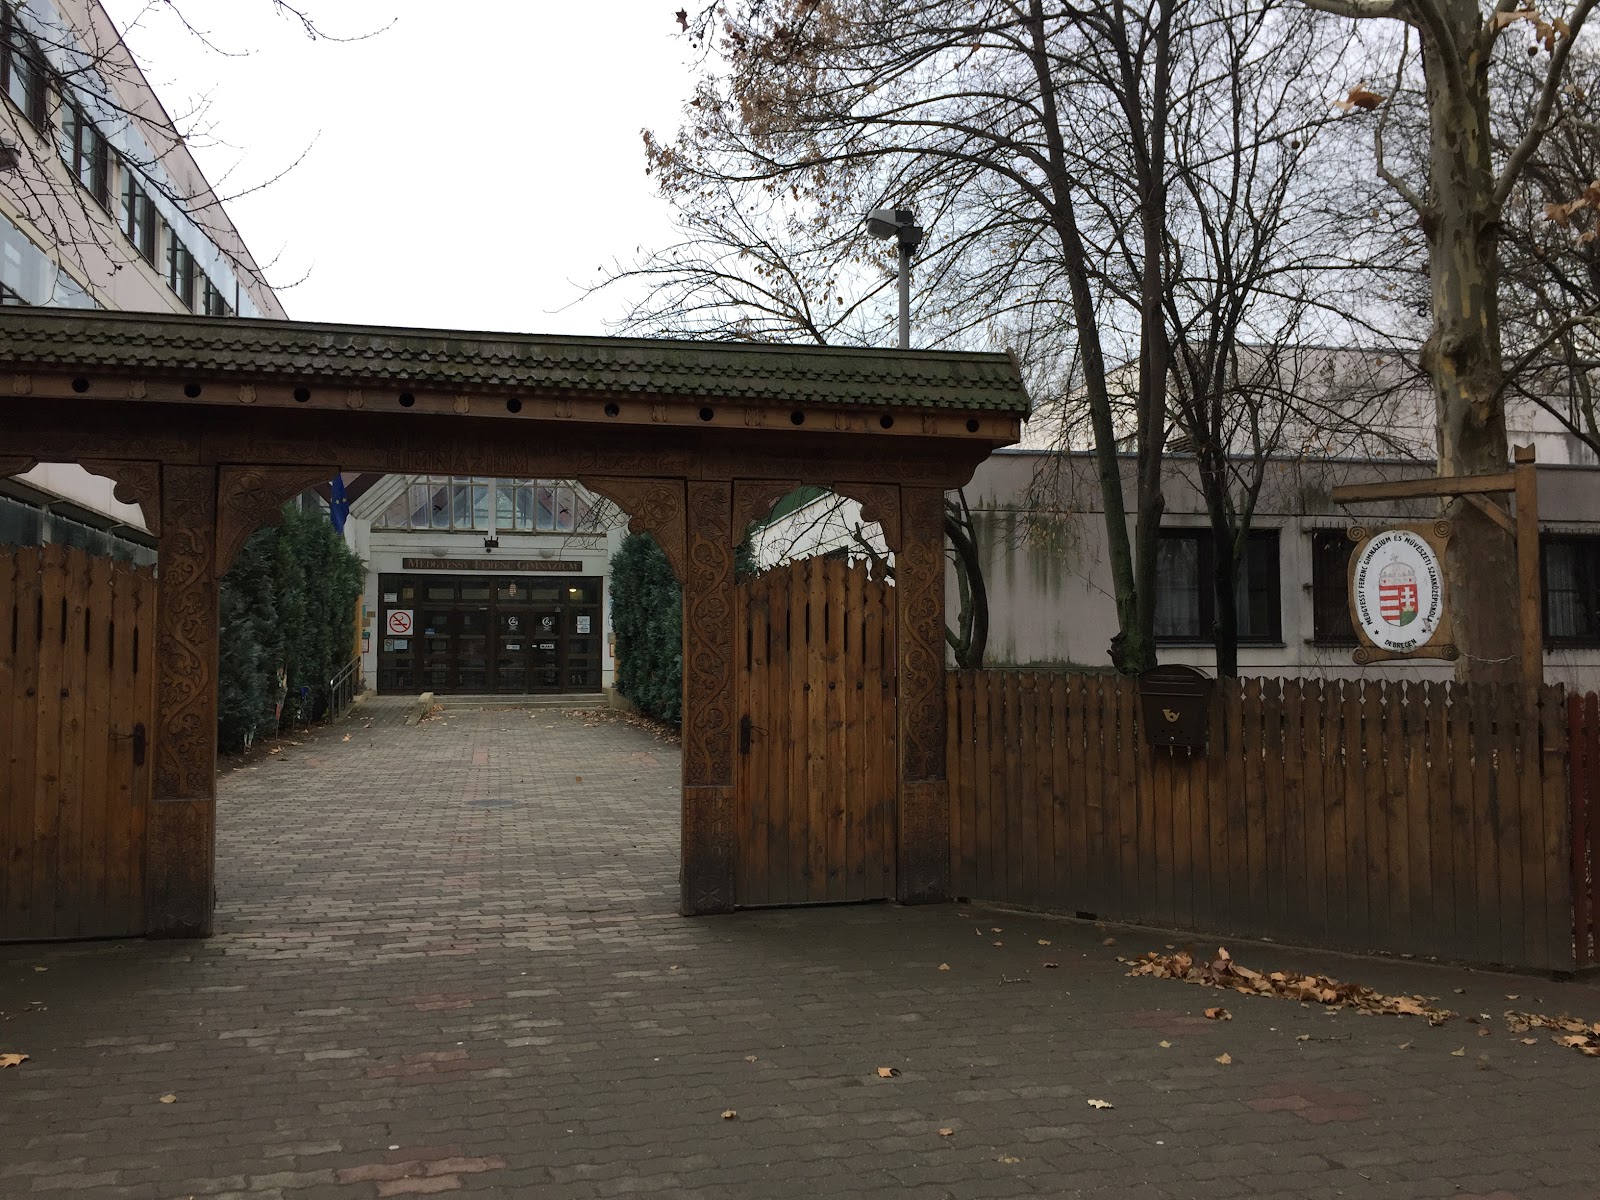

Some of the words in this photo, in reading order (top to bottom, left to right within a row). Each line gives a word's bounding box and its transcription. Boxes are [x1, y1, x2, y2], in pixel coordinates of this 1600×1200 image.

[1393, 534, 1402, 542] ÉS
[1363, 536, 1392, 566] GIMNÁZIUM
[407, 558, 468, 569] MEDGYESSY
[474, 559, 512, 570] FERENC
[1358, 566, 1368, 589] FERENC
[1358, 590, 1374, 626] MEDGYESSY
[1384, 638, 1417, 649] DEBRECEN
